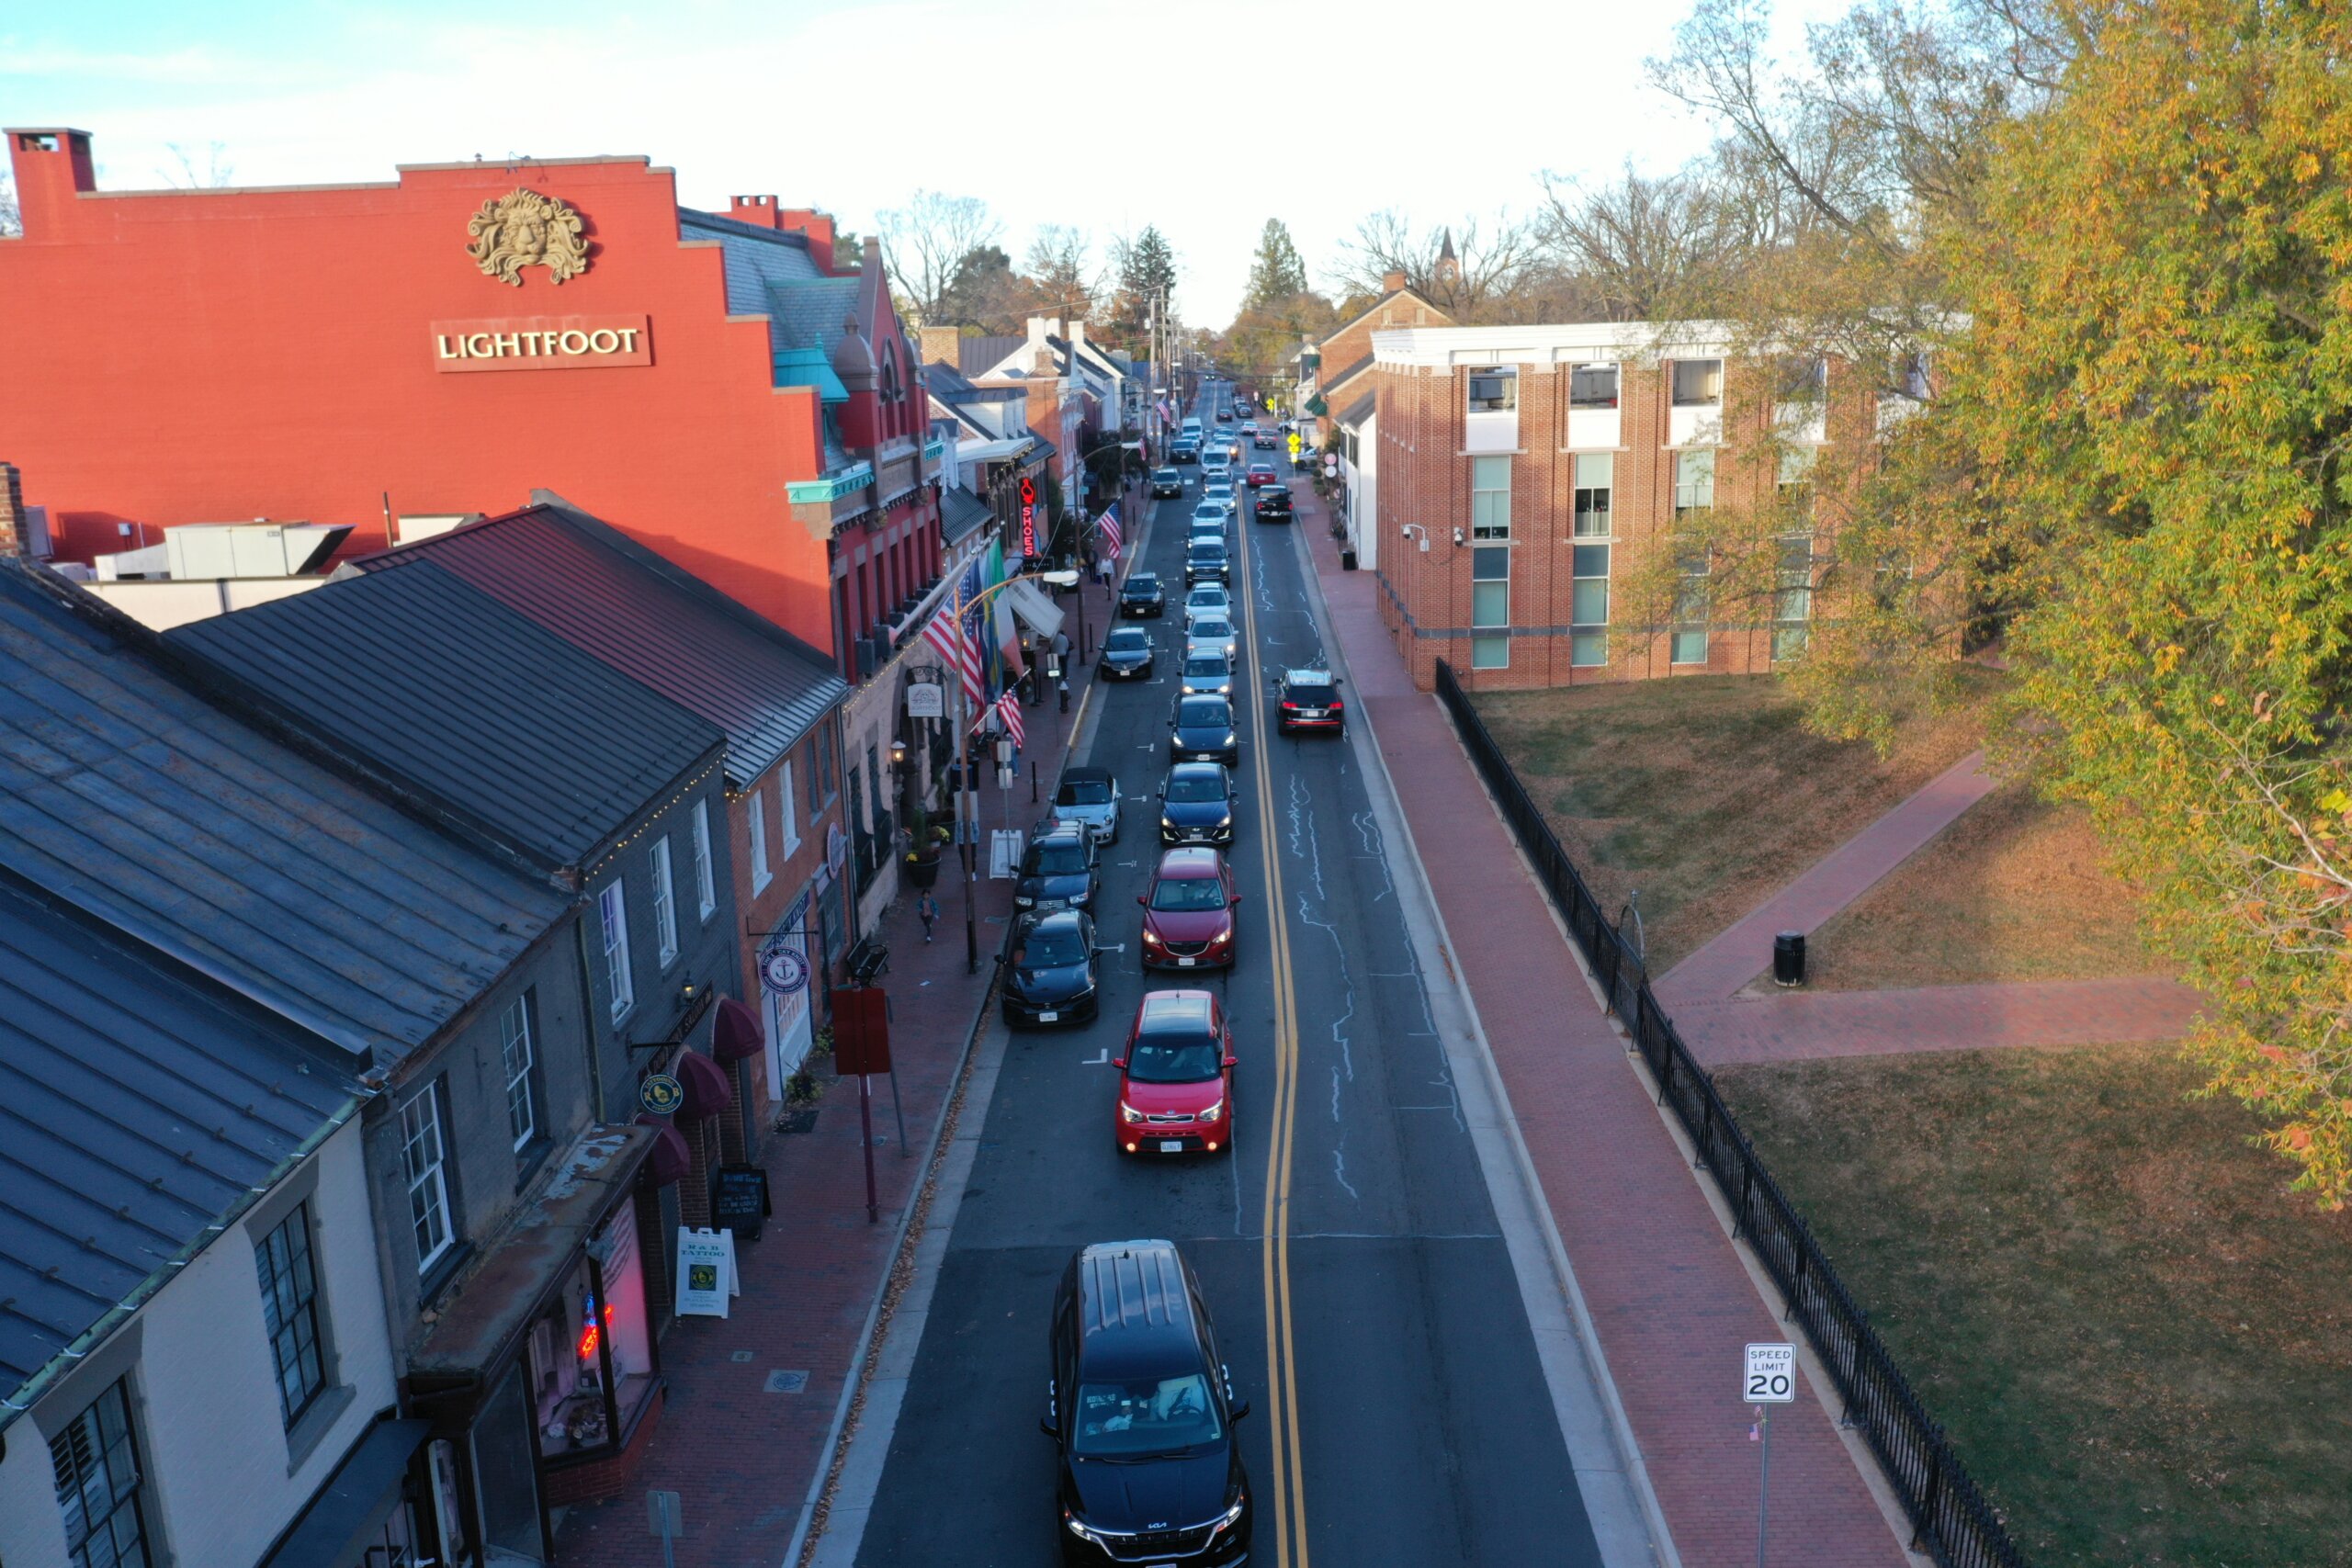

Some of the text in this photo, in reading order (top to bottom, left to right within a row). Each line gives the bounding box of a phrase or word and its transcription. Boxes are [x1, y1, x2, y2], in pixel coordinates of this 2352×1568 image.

[437, 328, 638, 359] LIGHTFOOT
[1023, 506, 1035, 556] SHOES
[682, 1249, 725, 1258] TATTOO
[1750, 1350, 1791, 1359] SPEED
[1754, 1362, 1785, 1371] LIMIT
[1748, 1375, 1790, 1395] 20
